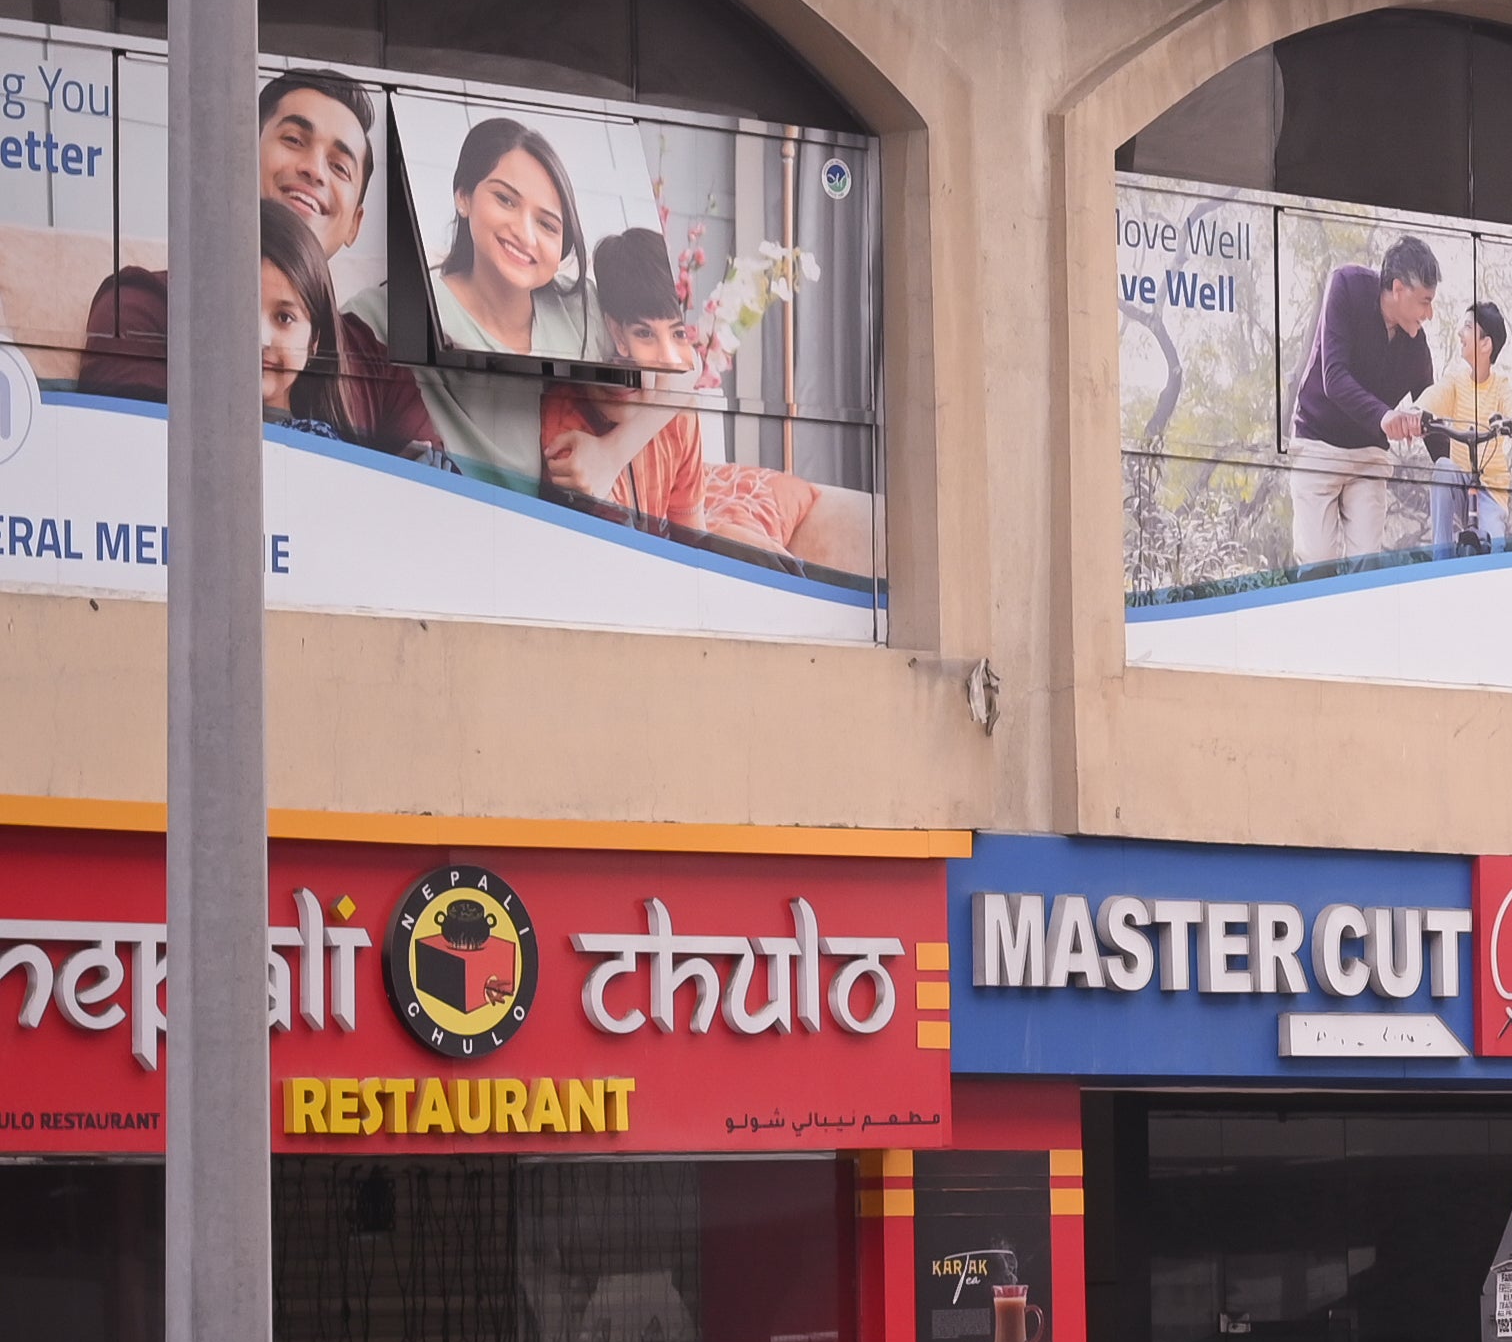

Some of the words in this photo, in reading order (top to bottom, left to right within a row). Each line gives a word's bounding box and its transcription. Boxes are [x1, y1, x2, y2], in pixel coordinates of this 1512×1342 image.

[38, 65, 110, 117] You
[0, 130, 103, 177] etter
[1187, 217, 1250, 261] Well
[1120, 273, 1156, 304] ve
[1165, 269, 1234, 313] Well
[0, 514, 84, 560] RAL
[401, 870, 530, 936] NEPALI
[570, 897, 905, 1036] chulo
[972, 892, 1310, 995] MASTER
[1311, 903, 1473, 999] CUT
[407, 1001, 526, 1055] CHULO
[0, 1112, 34, 1131] ULO
[40, 1112, 161, 1130] RESTAURANT
[283, 1076, 636, 1136] RESTAURANT
[724, 1107, 785, 1134] شولو
[791, 1110, 857, 1137] نيبالي
[861, 1110, 941, 1132] مطعم
